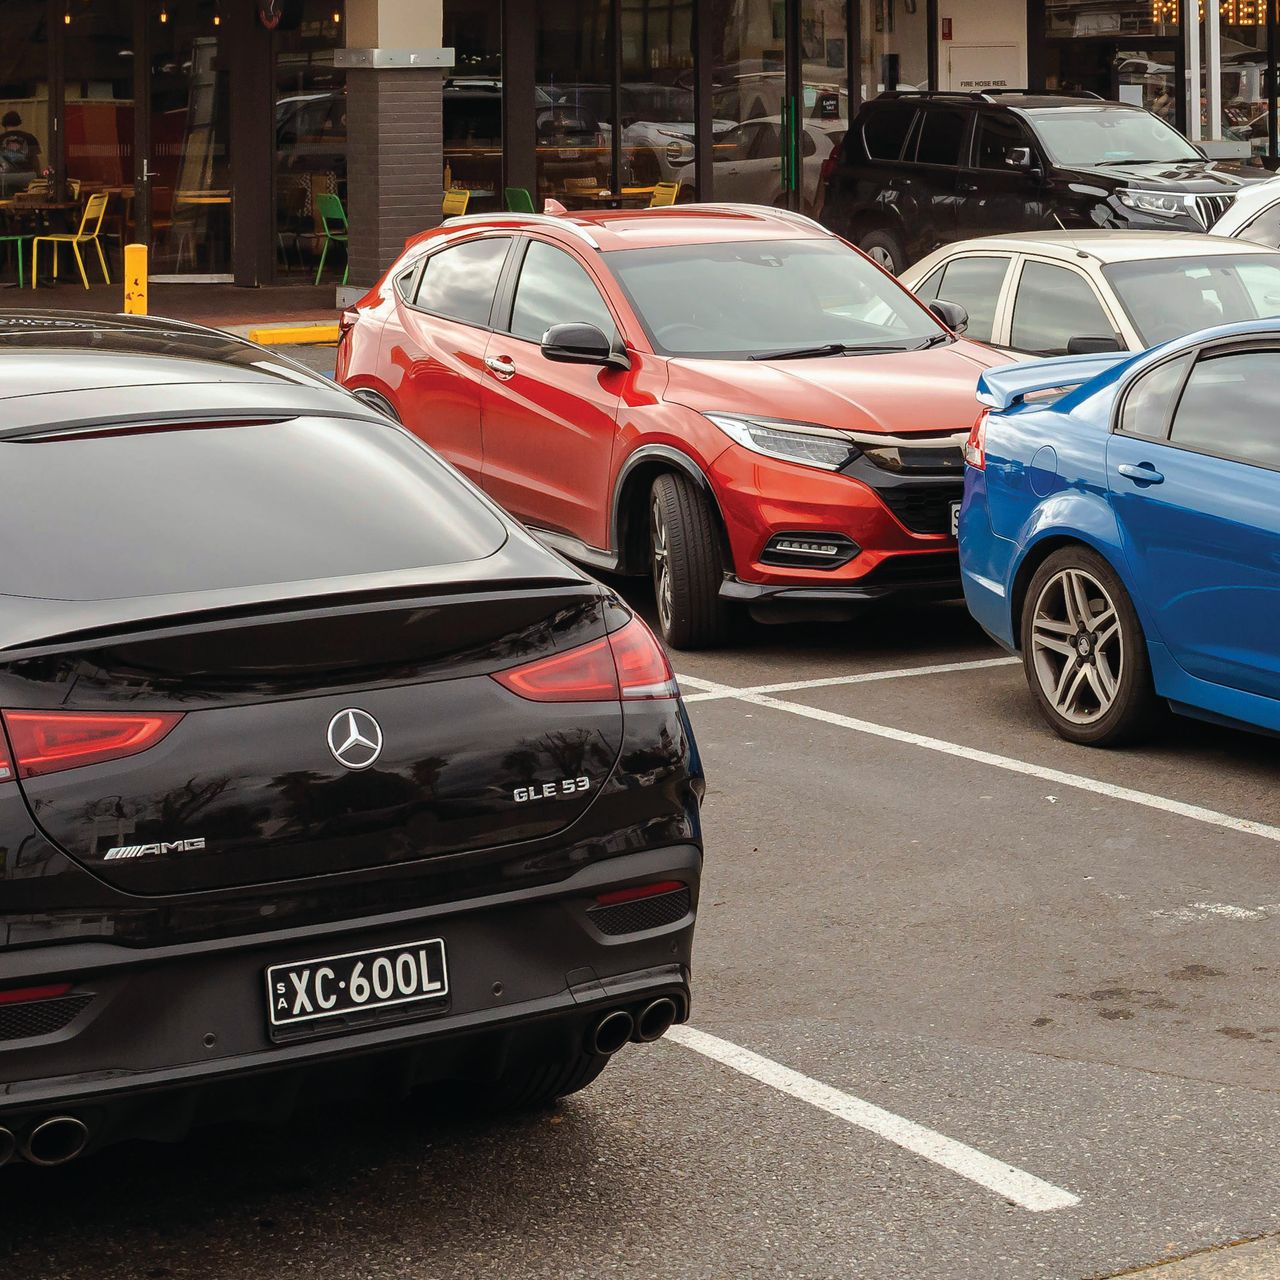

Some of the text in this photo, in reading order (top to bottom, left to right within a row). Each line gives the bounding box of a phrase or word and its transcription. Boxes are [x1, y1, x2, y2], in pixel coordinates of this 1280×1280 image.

[514, 776, 590, 802] GLE 53
[137, 837, 205, 857] AMG
